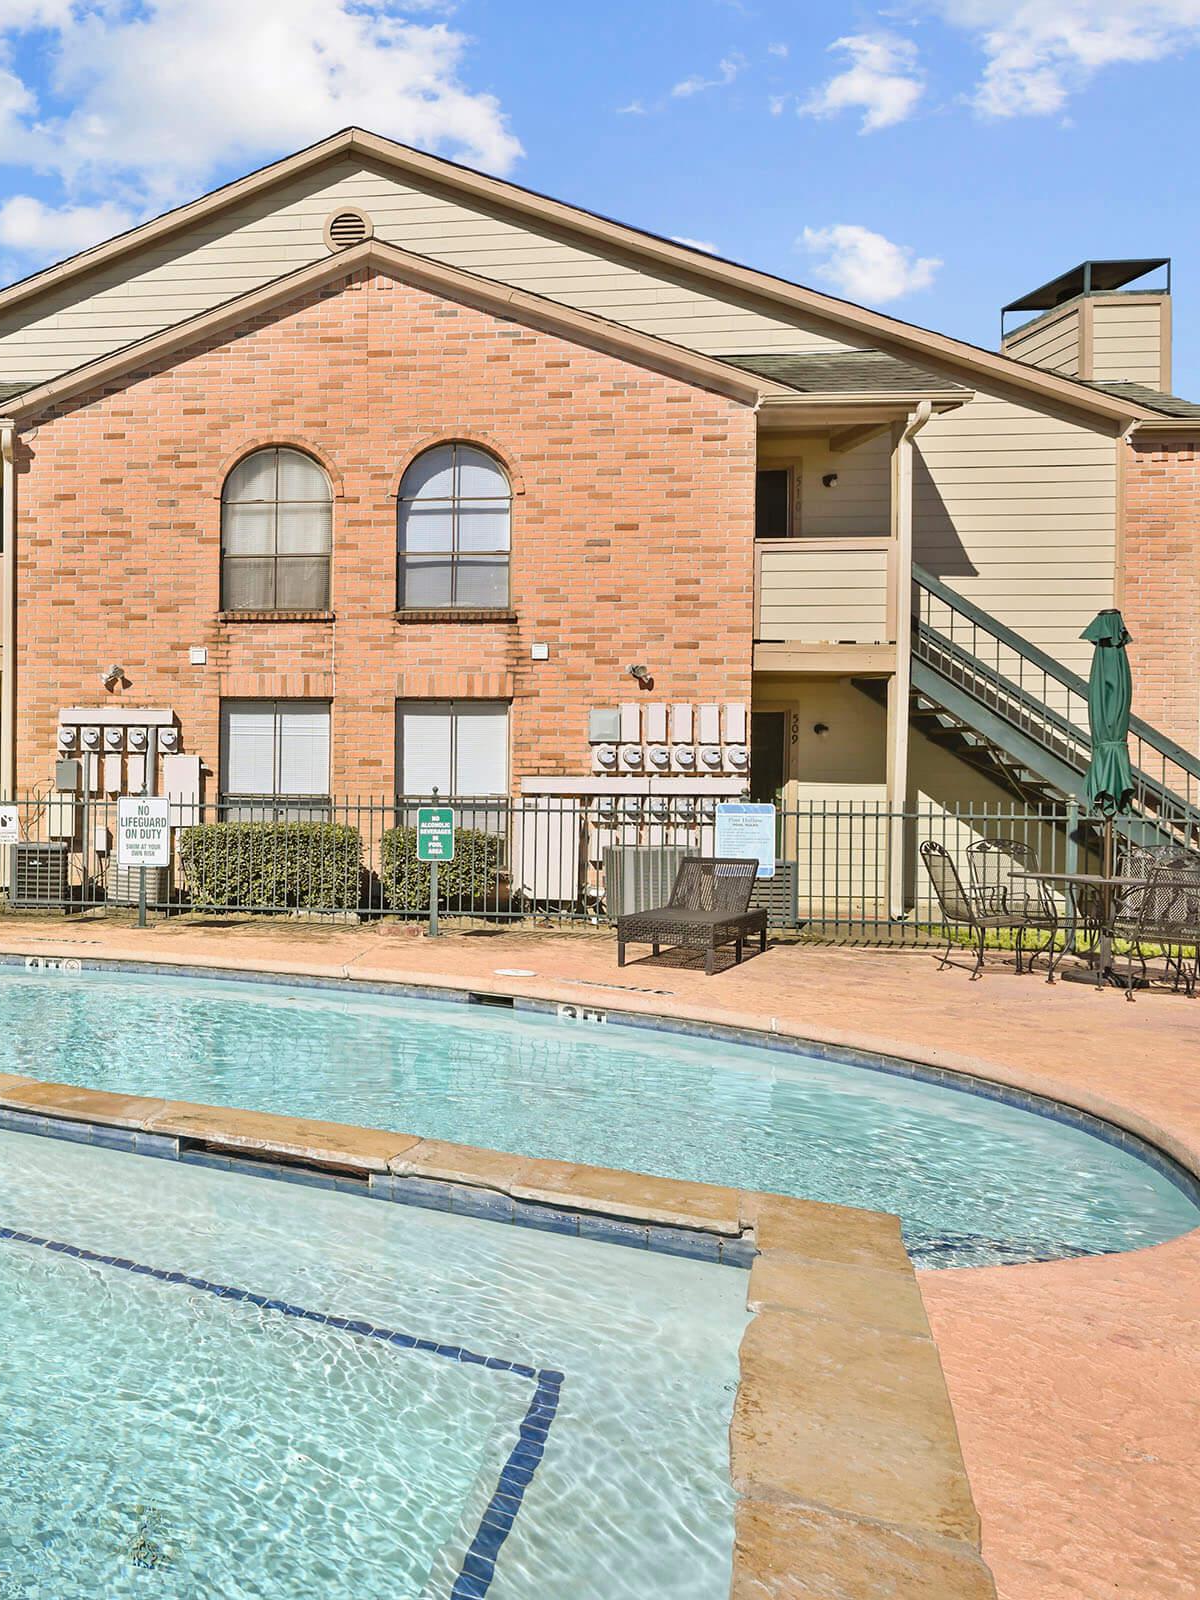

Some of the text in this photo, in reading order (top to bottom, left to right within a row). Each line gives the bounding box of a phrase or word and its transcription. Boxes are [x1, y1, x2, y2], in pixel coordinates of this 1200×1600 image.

[138, 805, 150, 816] NO
[120, 817, 167, 828] LIFEGUARD
[125, 829, 162, 839] ON DUTY
